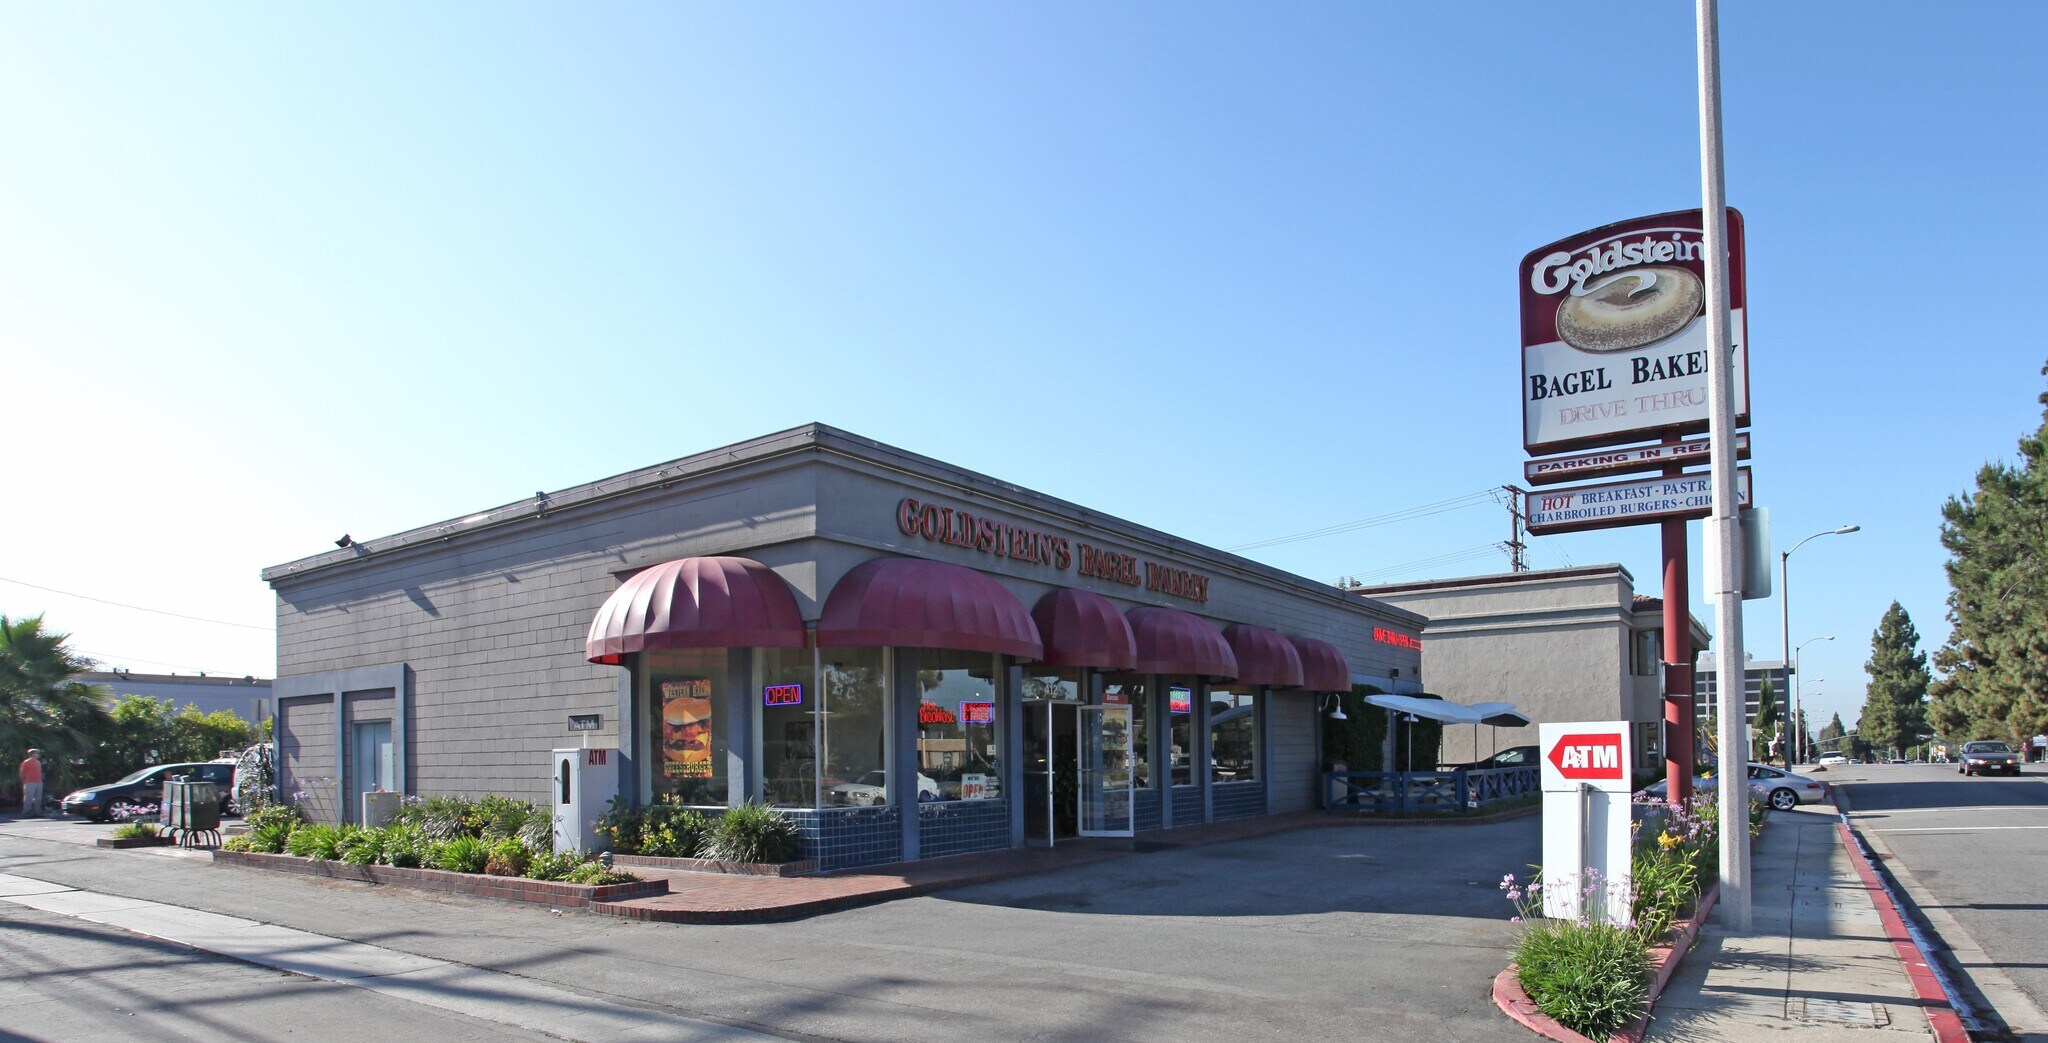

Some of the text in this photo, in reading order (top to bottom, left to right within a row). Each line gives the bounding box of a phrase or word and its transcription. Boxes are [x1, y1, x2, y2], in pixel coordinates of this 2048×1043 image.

[1531, 232, 1729, 297] Goldstein
[1530, 344, 1738, 401] BAGEL BAKE
[1559, 386, 1707, 426] DRIVE THRU
[1537, 442, 1711, 473] PARKING IN RE
[1529, 506, 1616, 524] CHARBROILED
[1620, 498, 1677, 515] BURGERS
[1541, 495, 1574, 511] HOT
[1581, 486, 1653, 505] BREAKFAST
[1663, 480, 1712, 496] PASTR
[898, 498, 1210, 601] GOLDSTEIN'S BAGEL BAKERY
[767, 687, 799, 704] OPEN
[574, 720, 595, 730] ATM
[588, 750, 607, 766] ATM
[1561, 745, 1618, 769] ATM
